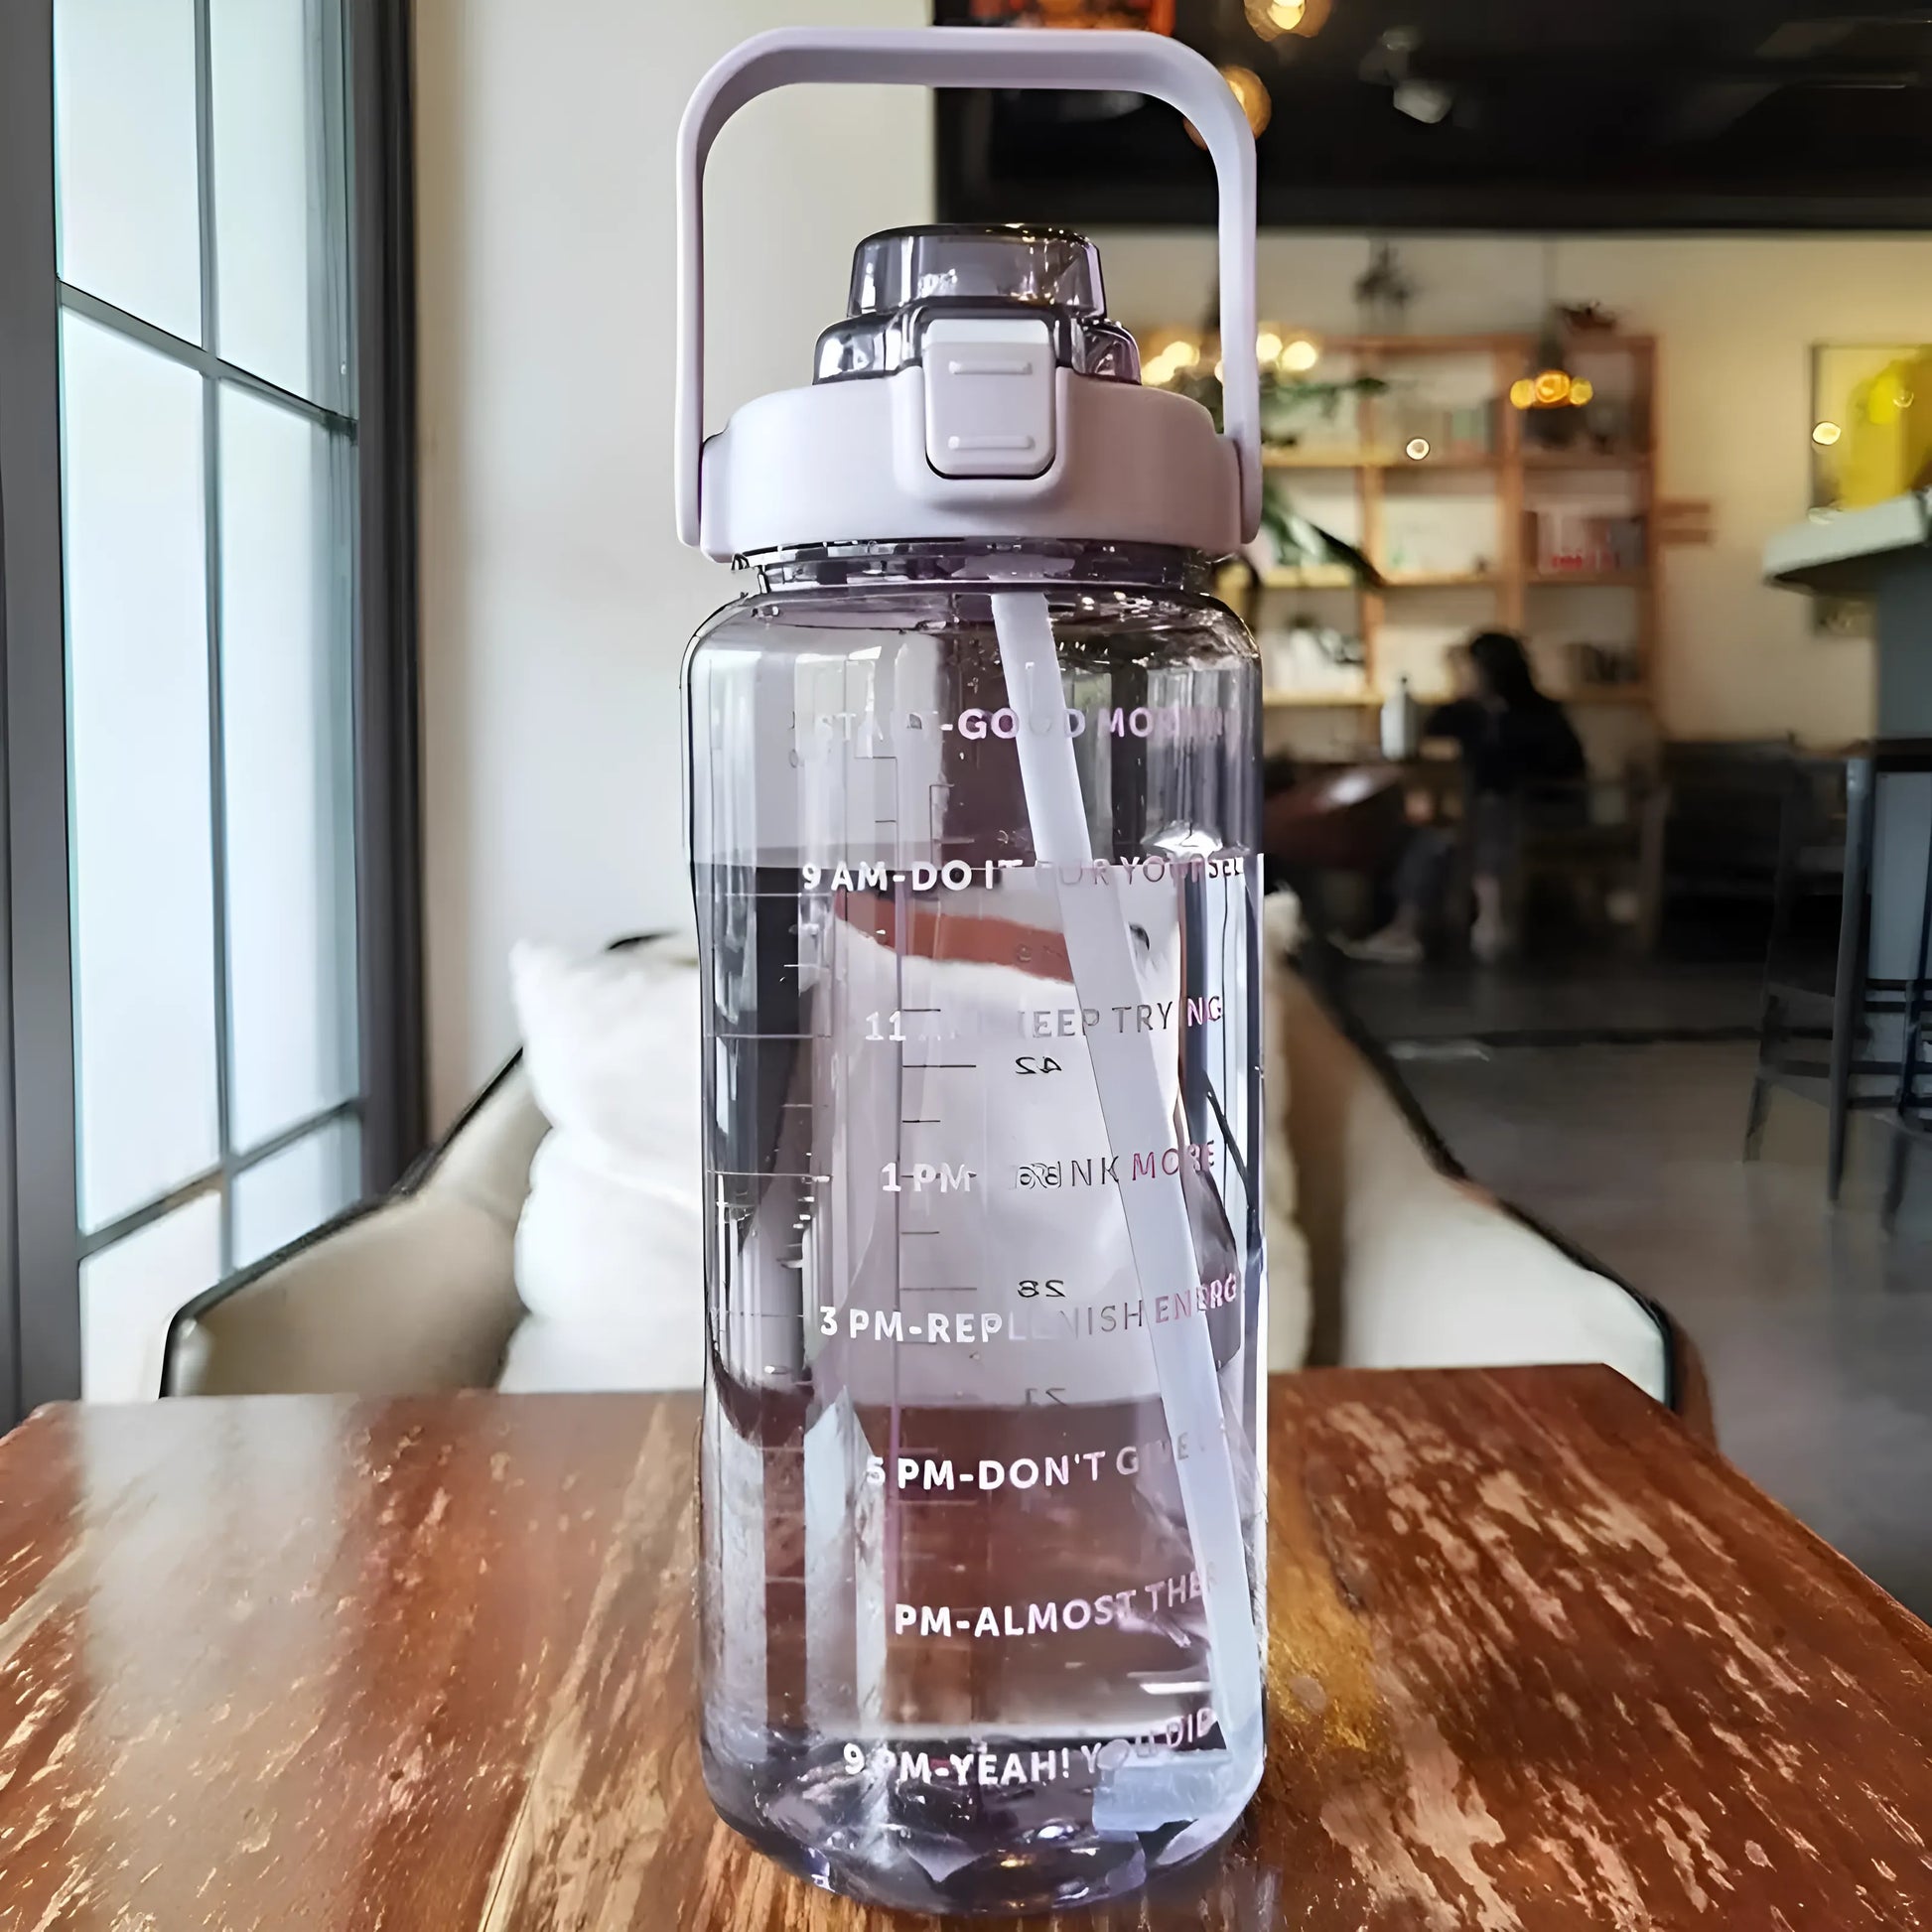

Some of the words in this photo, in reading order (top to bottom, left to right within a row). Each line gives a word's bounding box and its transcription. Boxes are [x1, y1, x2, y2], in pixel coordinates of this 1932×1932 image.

[802, 862, 821, 891] 9
[831, 860, 972, 892] AM-DO
[866, 1011, 906, 1040] 11
[1112, 996, 1221, 1034] TRYNG
[820, 1306, 838, 1335] 3
[866, 1454, 886, 1487] 5
[897, 1450, 1106, 1490] PM-DON'T
[895, 1589, 1137, 1638] PM-ALMOST
[844, 1742, 865, 1775] 9
